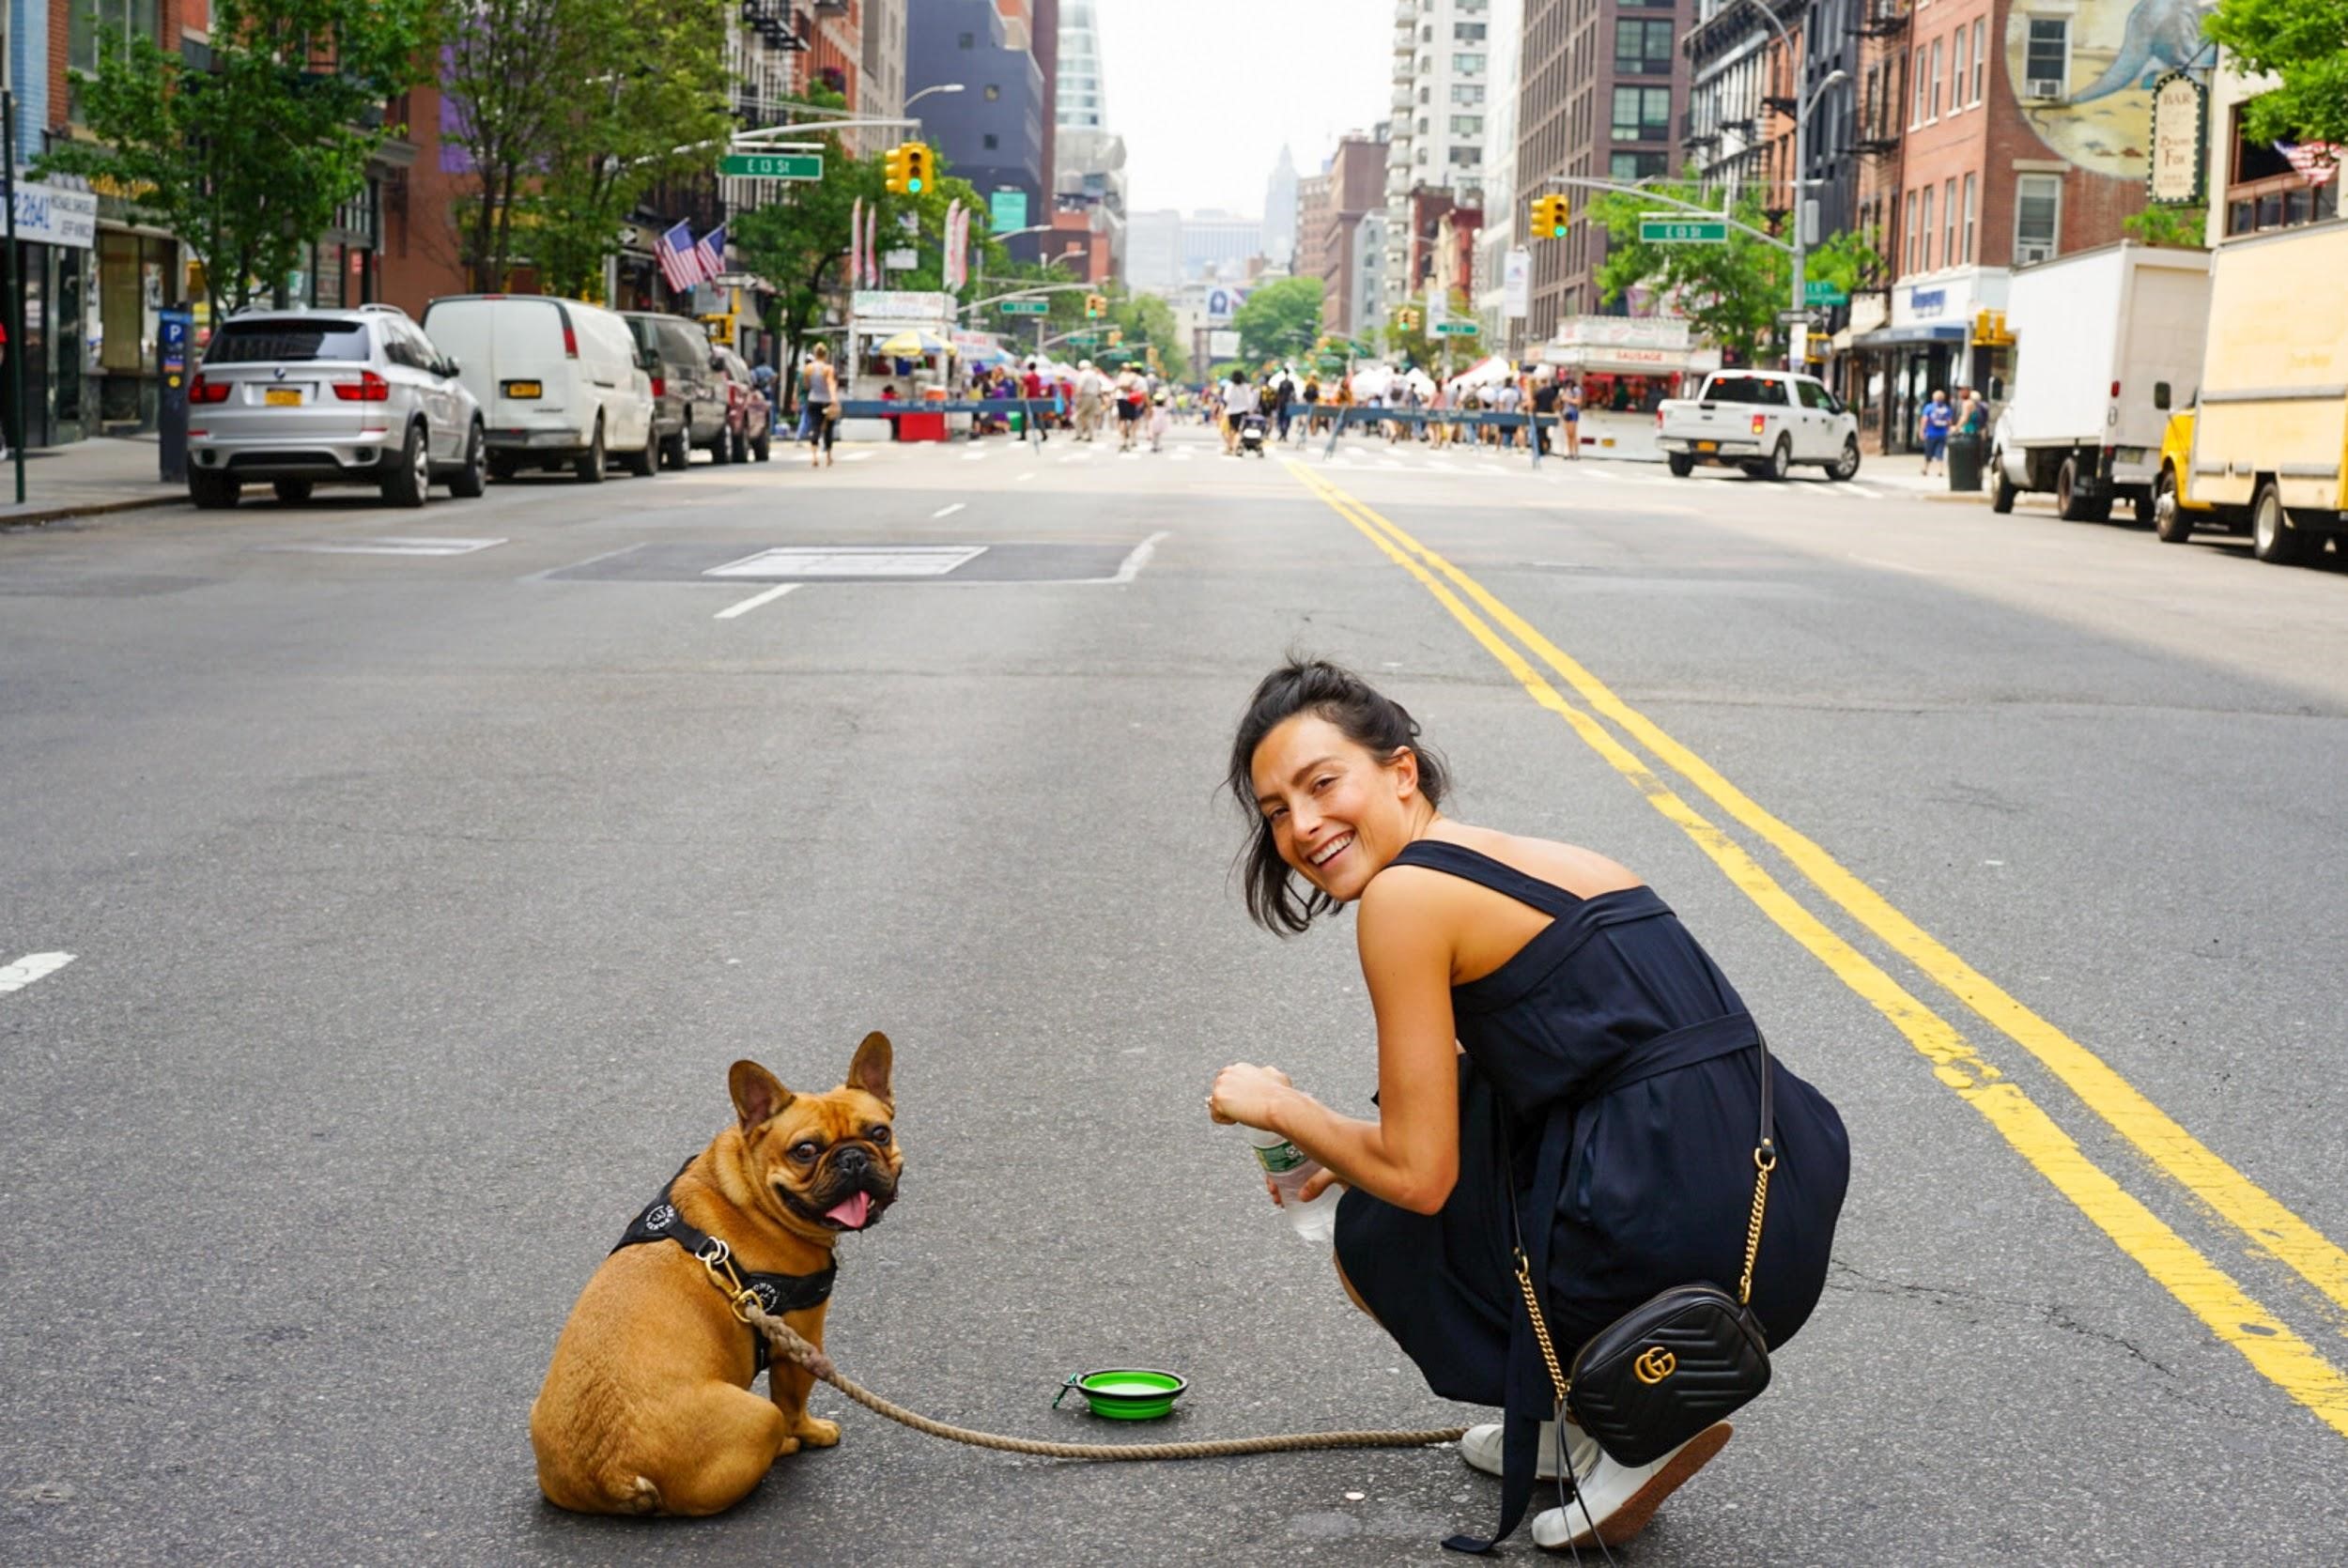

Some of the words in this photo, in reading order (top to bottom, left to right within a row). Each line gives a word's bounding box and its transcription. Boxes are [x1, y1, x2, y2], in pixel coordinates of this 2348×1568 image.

[747, 159, 755, 173] E
[760, 159, 773, 173] 13
[777, 159, 791, 174] St
[1665, 226, 1673, 238] E
[170, 324, 181, 342] P
